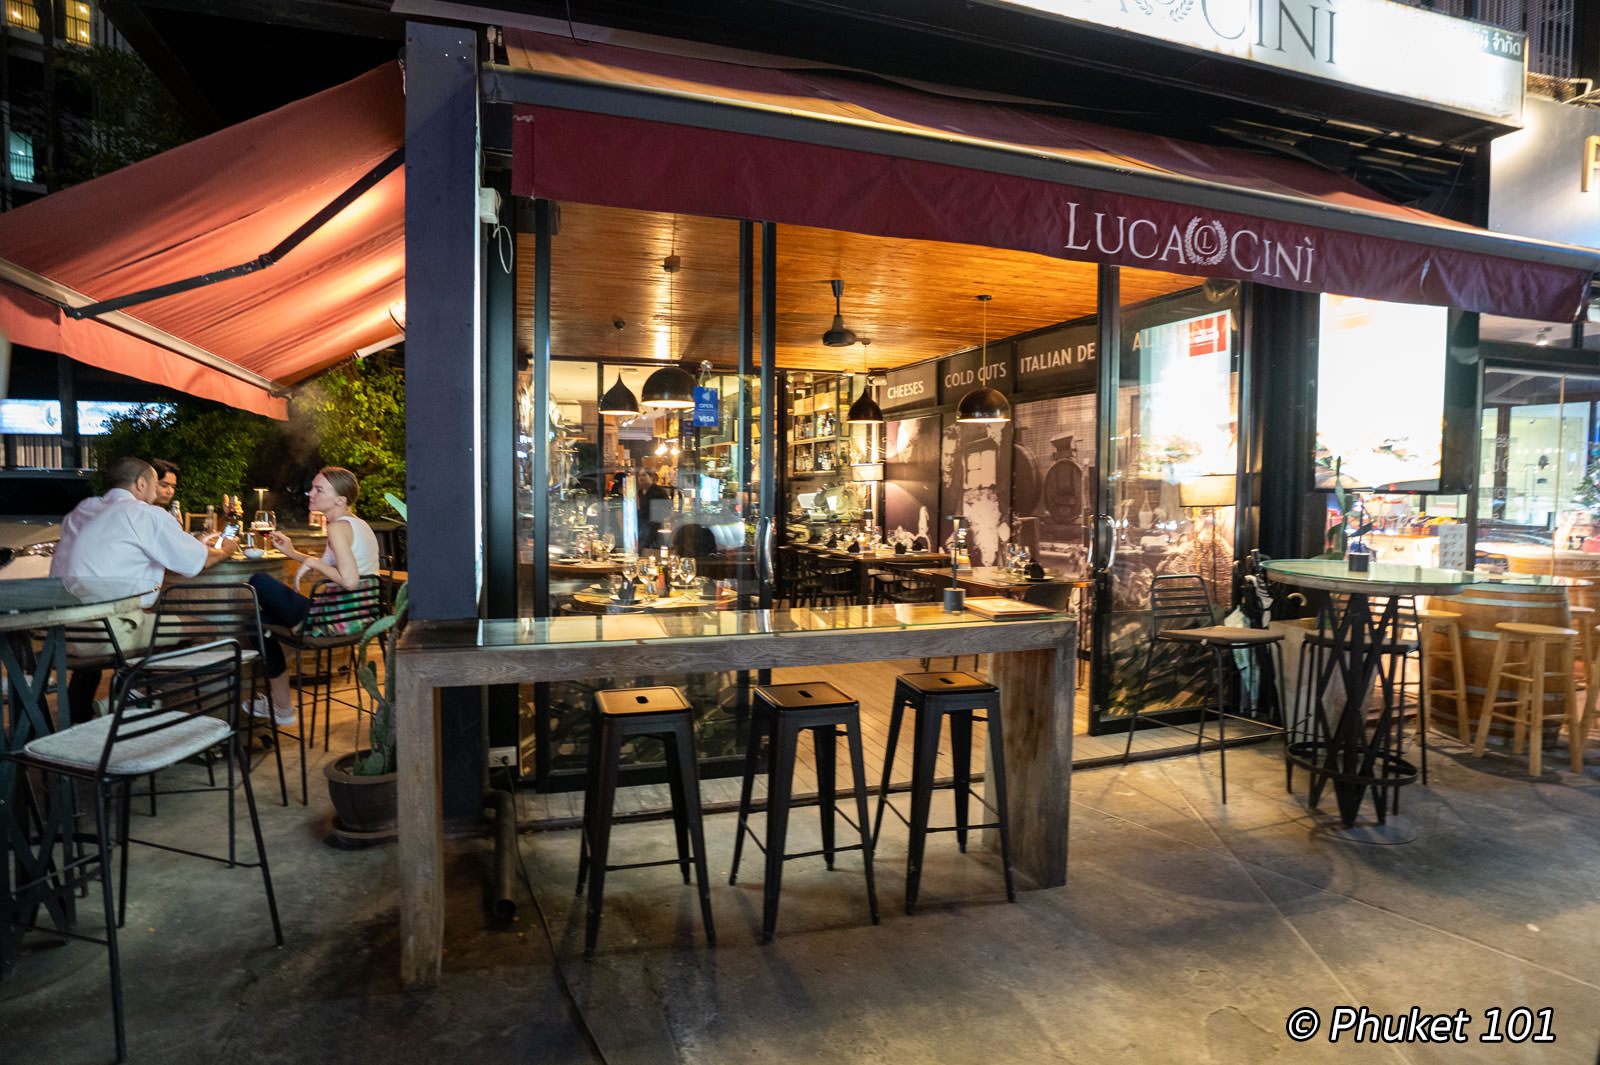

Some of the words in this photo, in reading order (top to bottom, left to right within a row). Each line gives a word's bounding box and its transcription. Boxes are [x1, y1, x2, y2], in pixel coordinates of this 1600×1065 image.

[1064, 202, 1188, 265] LUCA
[1020, 347, 1073, 374] ITALIAN
[944, 369, 974, 388] COLD
[977, 361, 1007, 382] CUTS
[887, 380, 925, 400] CHEESES
[698, 415, 715, 423] VISA
